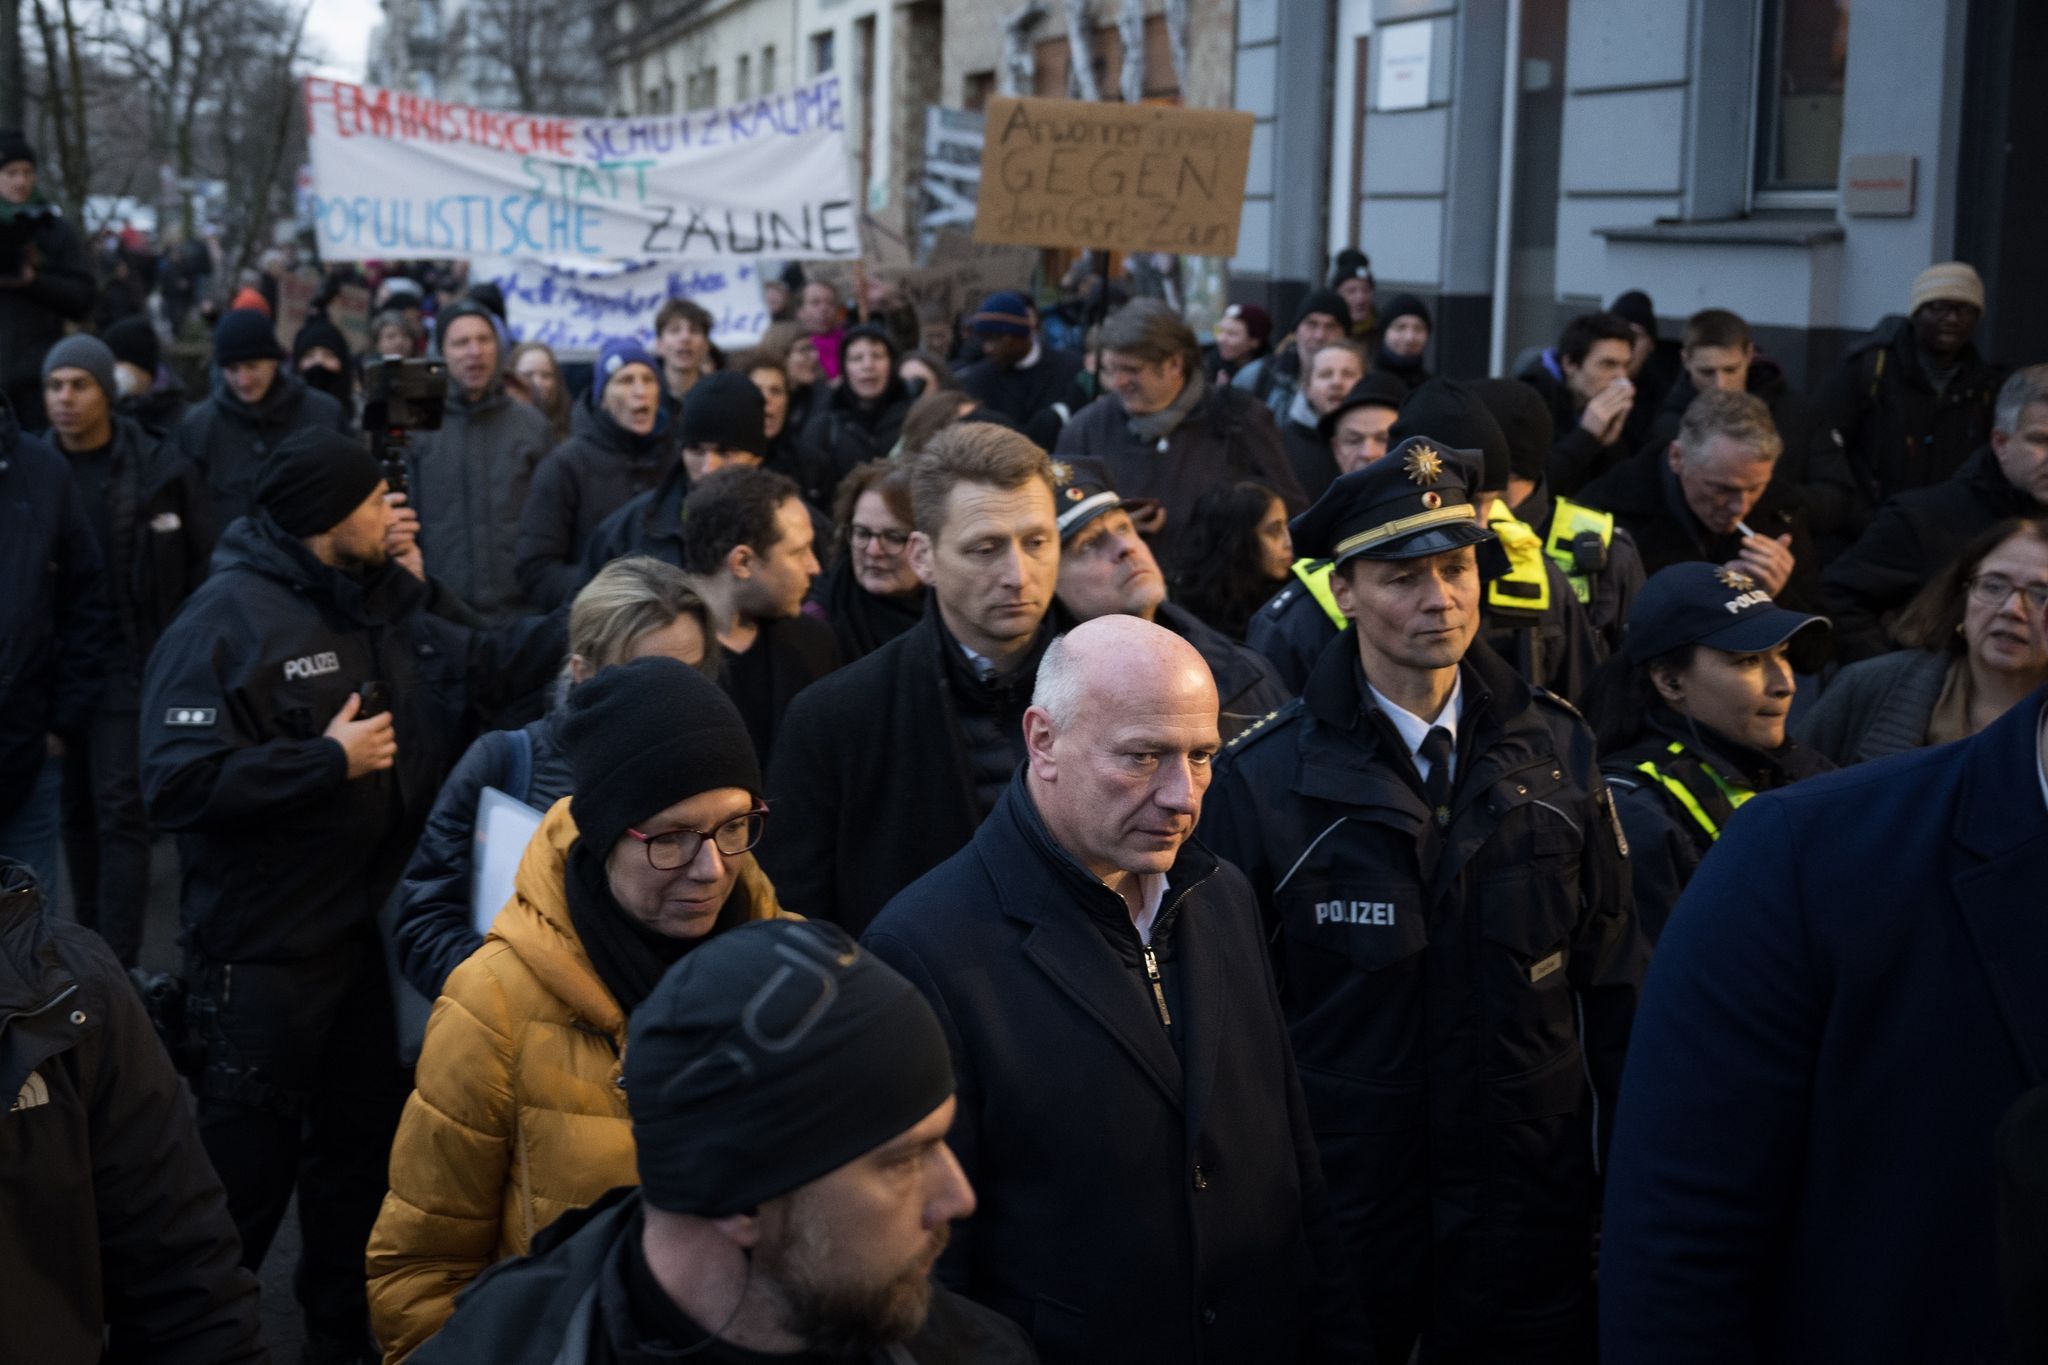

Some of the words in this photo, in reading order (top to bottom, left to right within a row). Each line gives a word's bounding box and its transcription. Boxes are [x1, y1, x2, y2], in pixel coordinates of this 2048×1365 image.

[304, 75, 576, 157] FEMINISTISCHE
[521, 156, 657, 203] STATT
[1000, 146, 1222, 200] GEGEN
[1315, 900, 1395, 925] POLIZEI
